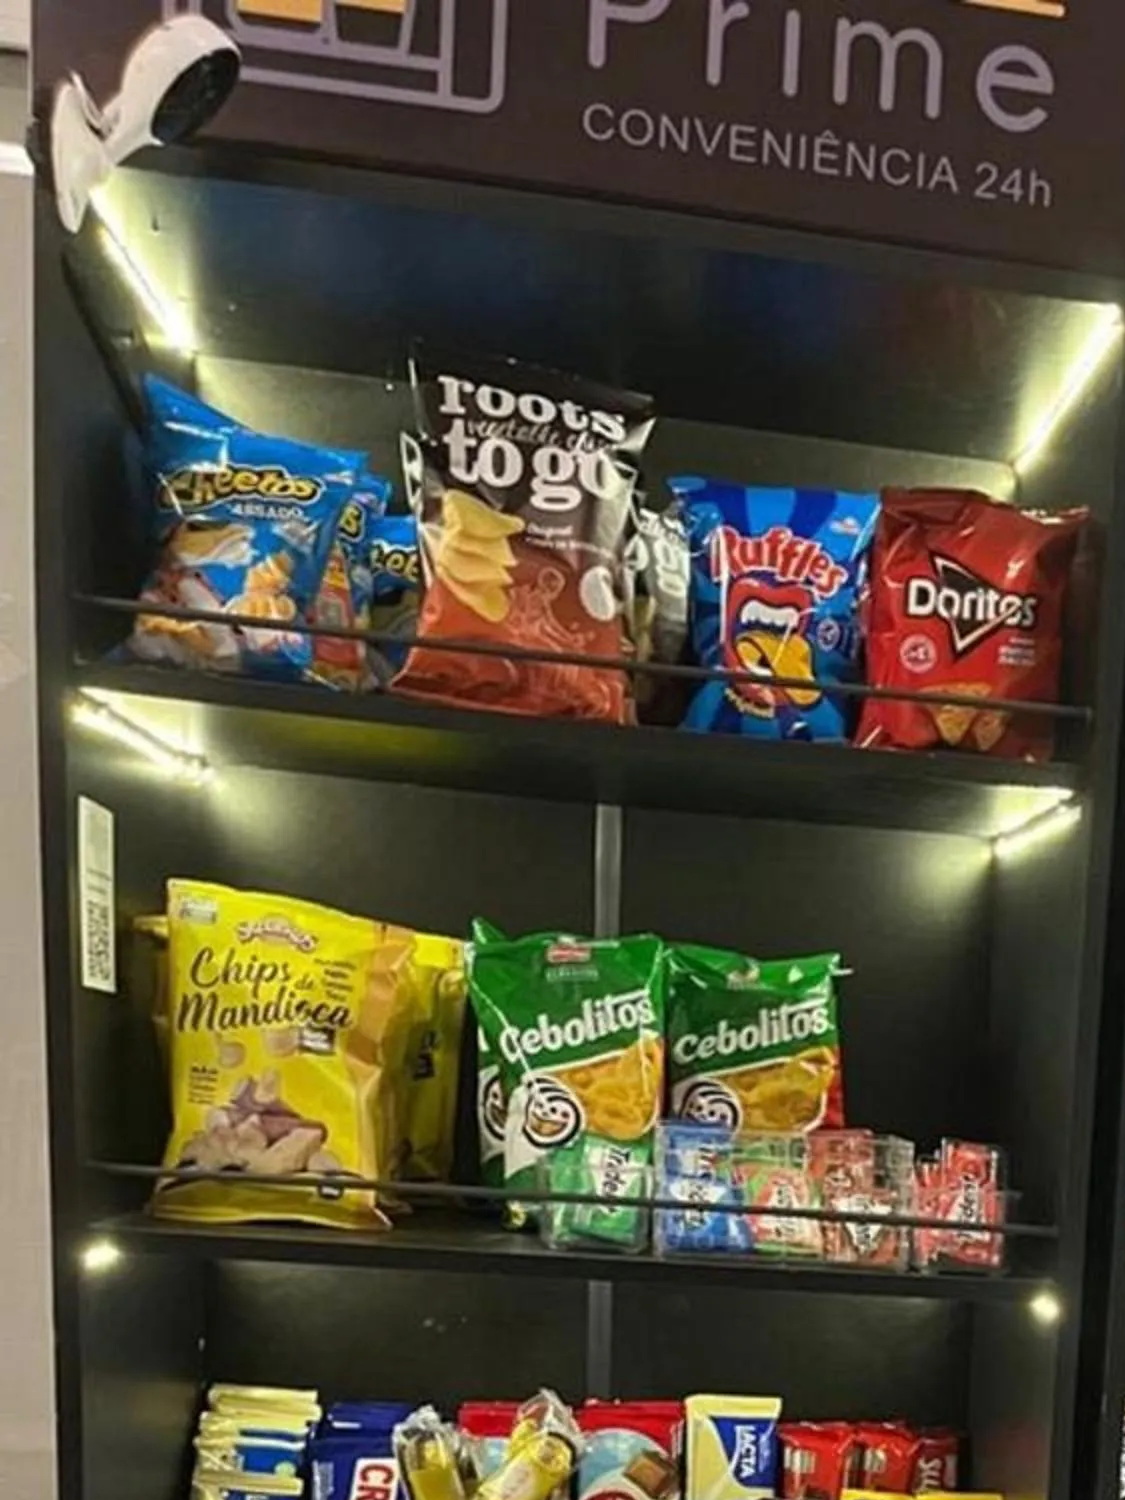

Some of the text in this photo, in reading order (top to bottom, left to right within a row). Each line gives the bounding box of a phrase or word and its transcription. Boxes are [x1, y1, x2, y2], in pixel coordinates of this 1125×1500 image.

[581, 103, 1052, 208] CONVENIÊNCIA 24h
[436, 375, 627, 442] roots
[442, 418, 620, 512] to go
[710, 523, 850, 598] Ruffles
[906, 576, 1038, 629] Doritos
[190, 947, 292, 1000] Chips
[176, 986, 353, 1033] Mandioca
[500, 989, 657, 1062] Cebolitos
[673, 997, 836, 1065] Cebolitos
